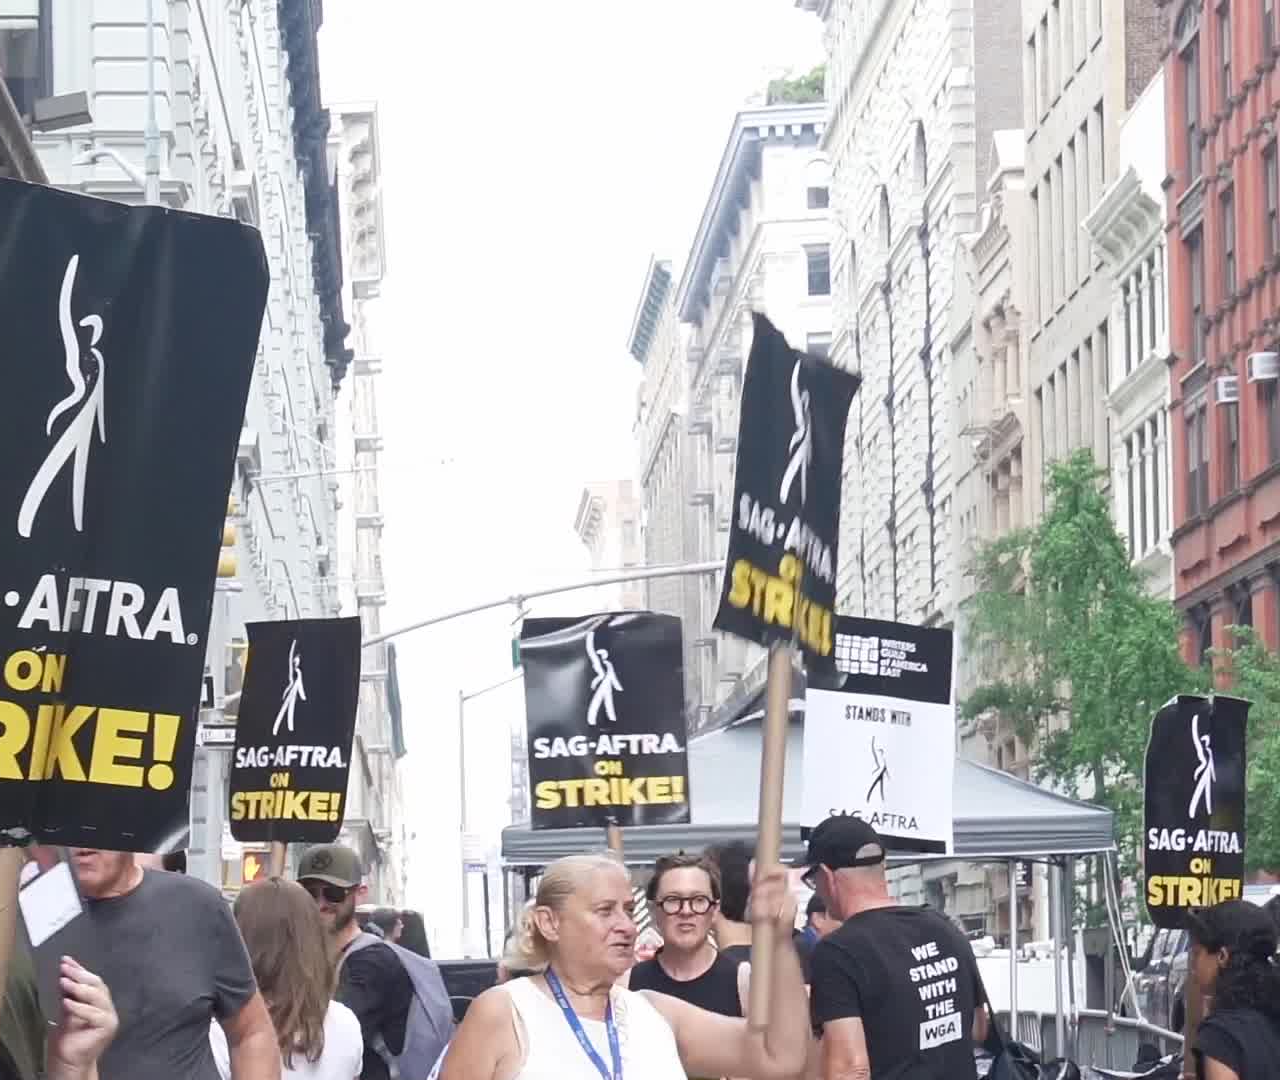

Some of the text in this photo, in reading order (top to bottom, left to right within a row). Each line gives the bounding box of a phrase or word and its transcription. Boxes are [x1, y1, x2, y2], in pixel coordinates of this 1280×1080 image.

[4, 649, 66, 693] ON
[891, 659, 928, 673] AMERICA
[845, 705, 913, 727] STANDS WITH
[594, 760, 623, 776] ON
[270, 772, 289, 788] ON
[535, 775, 685, 810] STRIKE!
[231, 790, 342, 822] STRIKE!
[1190, 857, 1211, 875] ON
[911, 941, 940, 962] WE
[909, 956, 959, 982] STAND
[918, 977, 958, 1001] WITH
[925, 998, 955, 1019] THE
[925, 1021, 956, 1041] WGA
